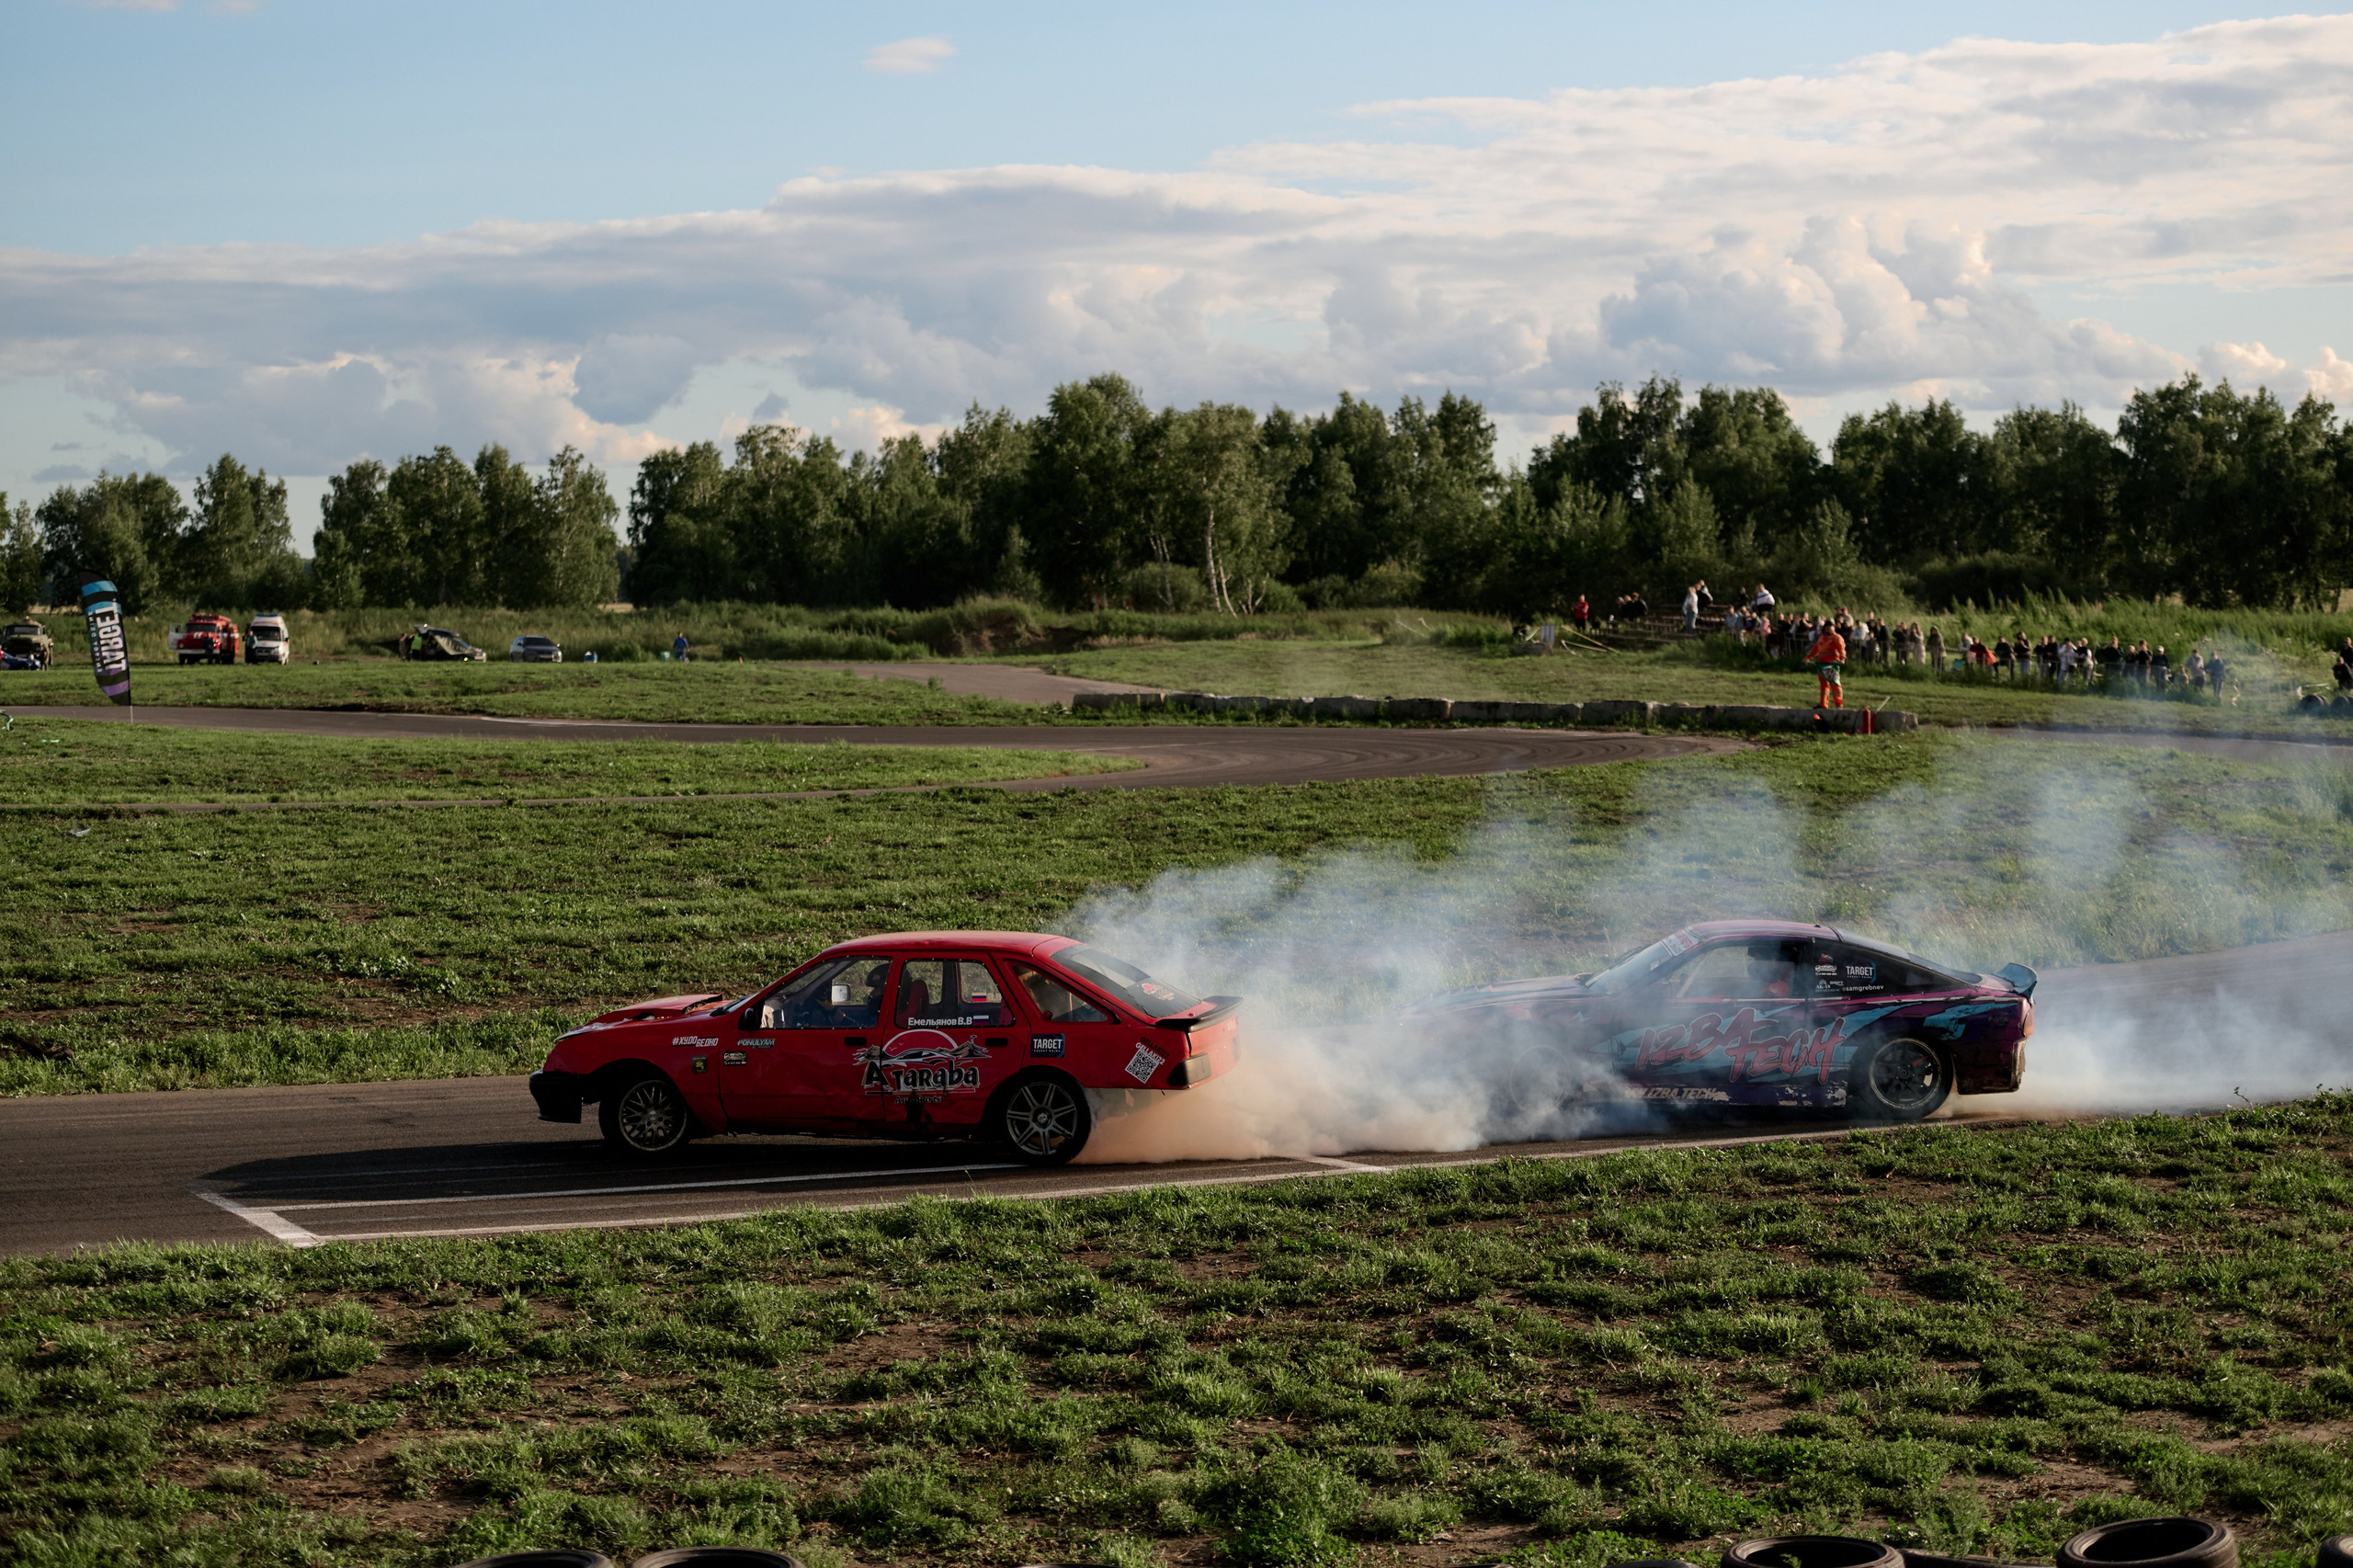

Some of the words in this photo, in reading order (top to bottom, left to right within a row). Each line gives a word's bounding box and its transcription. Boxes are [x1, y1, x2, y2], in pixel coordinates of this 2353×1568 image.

[1846, 965, 1874, 976] TARGET
[907, 1017, 957, 1026] Емельянов
[1032, 1039, 1063, 1050] TARGET
[1636, 1007, 1779, 1072] IZBA
[1724, 1016, 1846, 1085] TECH
